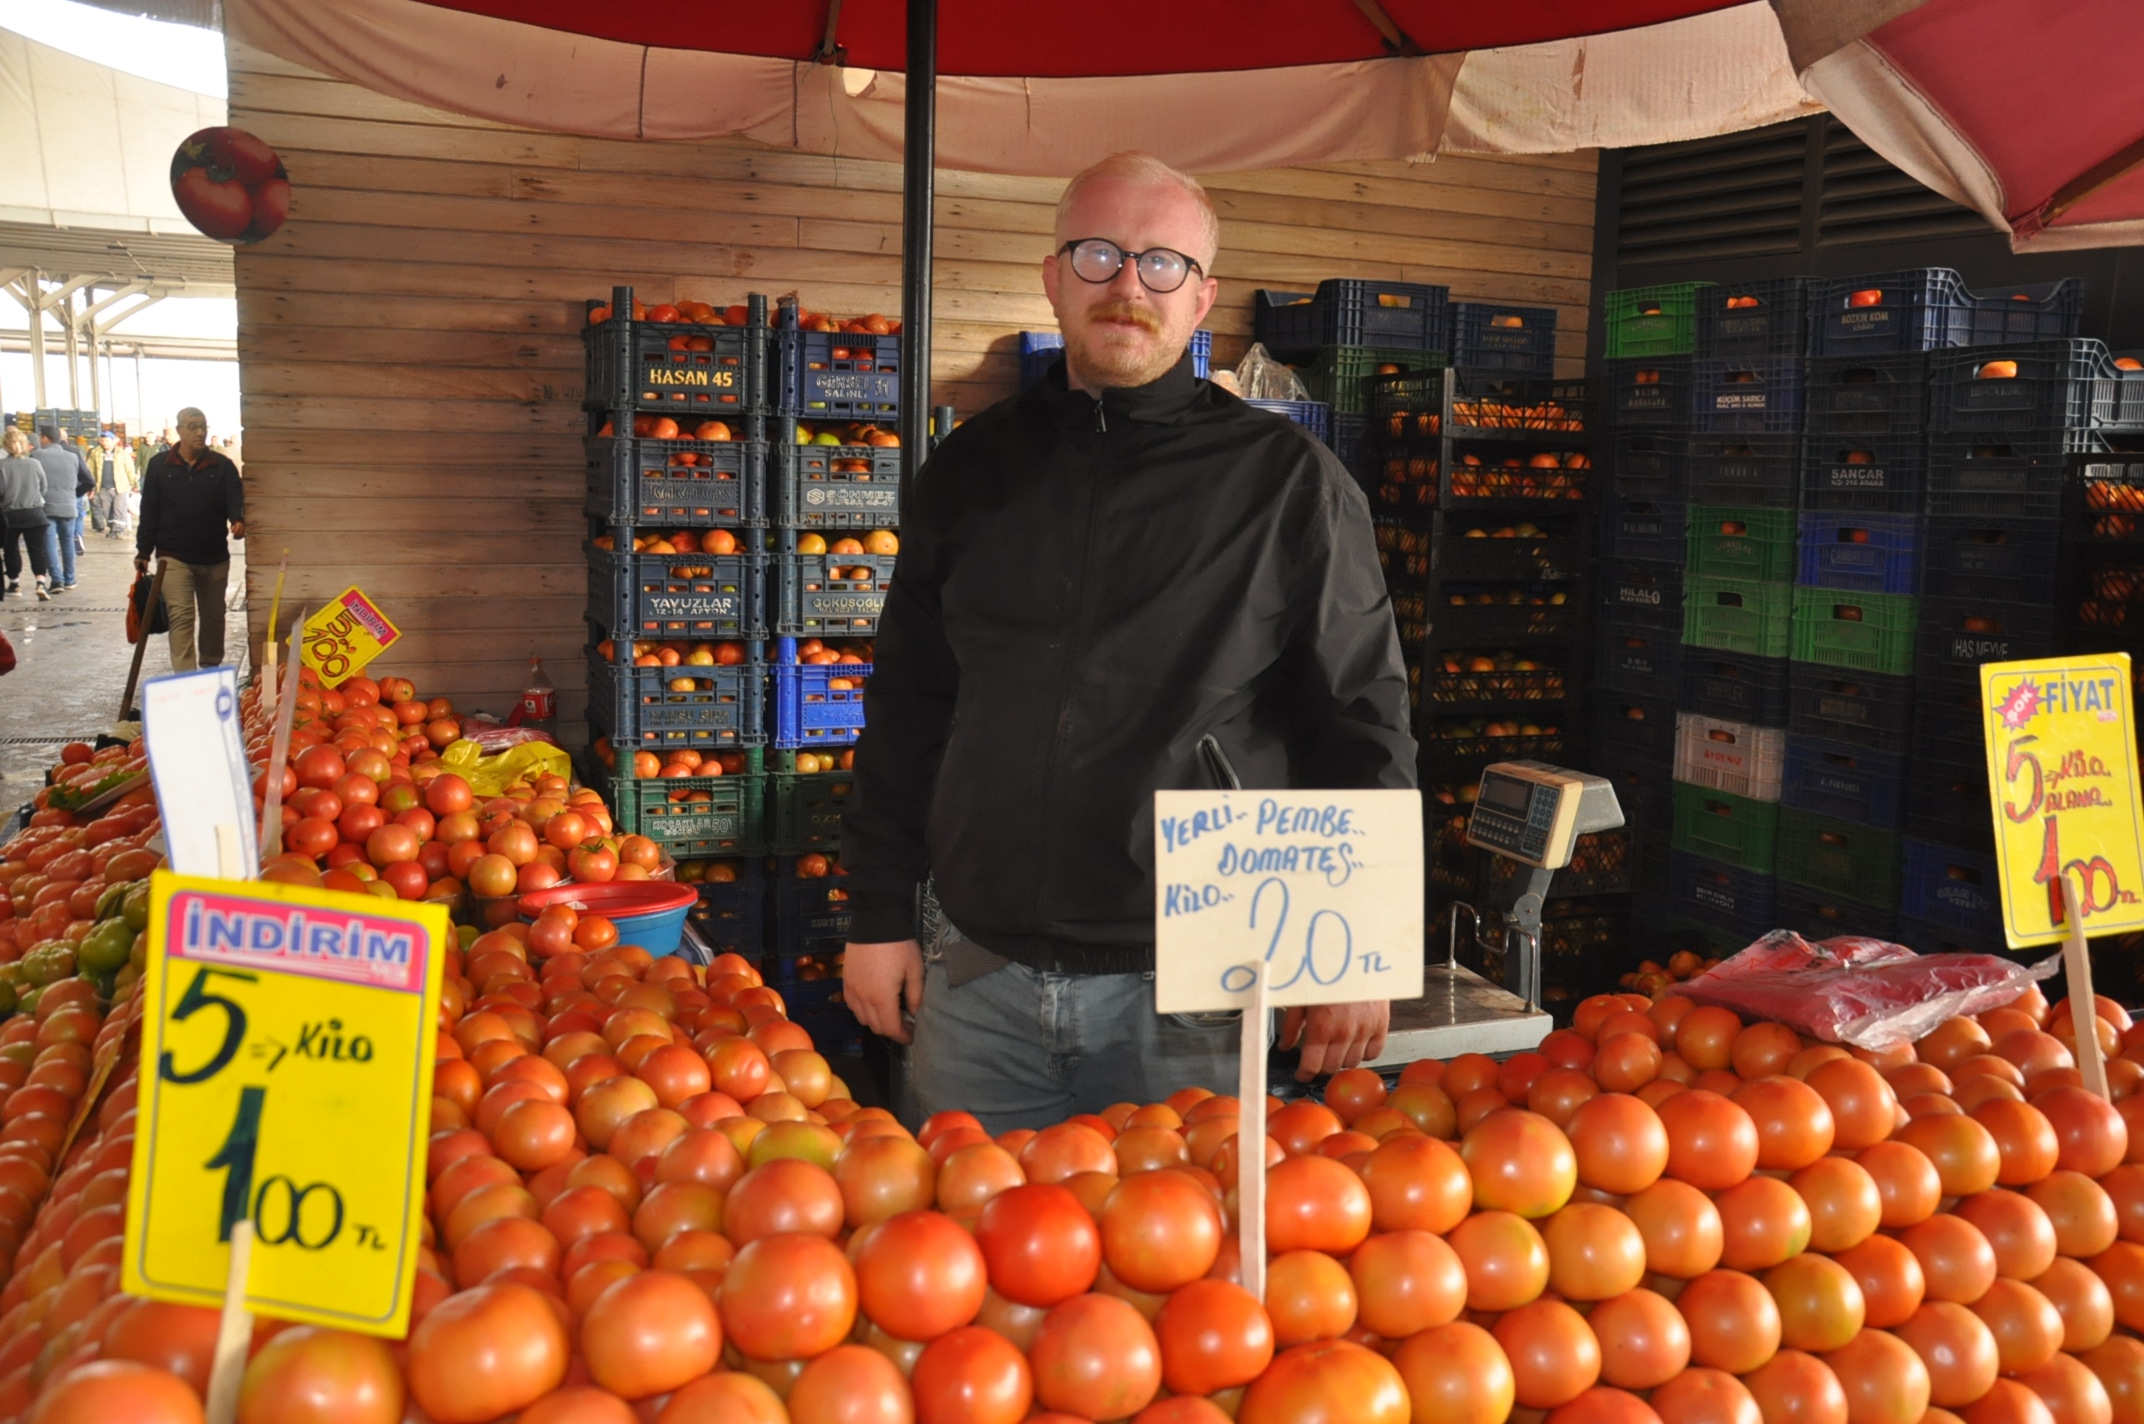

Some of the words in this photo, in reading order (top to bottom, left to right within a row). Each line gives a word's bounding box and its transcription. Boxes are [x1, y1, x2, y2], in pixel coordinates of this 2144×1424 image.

[649, 368, 708, 386] HASAN
[712, 371, 733, 387] 45
[1831, 468, 1884, 480] SANCAR
[826, 488, 896, 500] SÖNMEZ
[349, 598, 388, 637] İNDİRİM
[650, 597, 732, 609] YAVUZLAR
[656, 608, 684, 616] 12-14
[326, 608, 362, 638] 5
[1955, 639, 1974, 659] HAS
[2005, 687, 2034, 723] ŞOK
[2044, 673, 2115, 715] FİYAT
[2004, 734, 2043, 824] 5
[2033, 814, 2118, 928] 100
[184, 898, 410, 965] İNDİRİM
[1220, 876, 1352, 992] 20
[1358, 951, 1392, 974] TL
[158, 966, 260, 1085] 5
[203, 1087, 345, 1252] 100
[353, 1223, 388, 1251] TL
